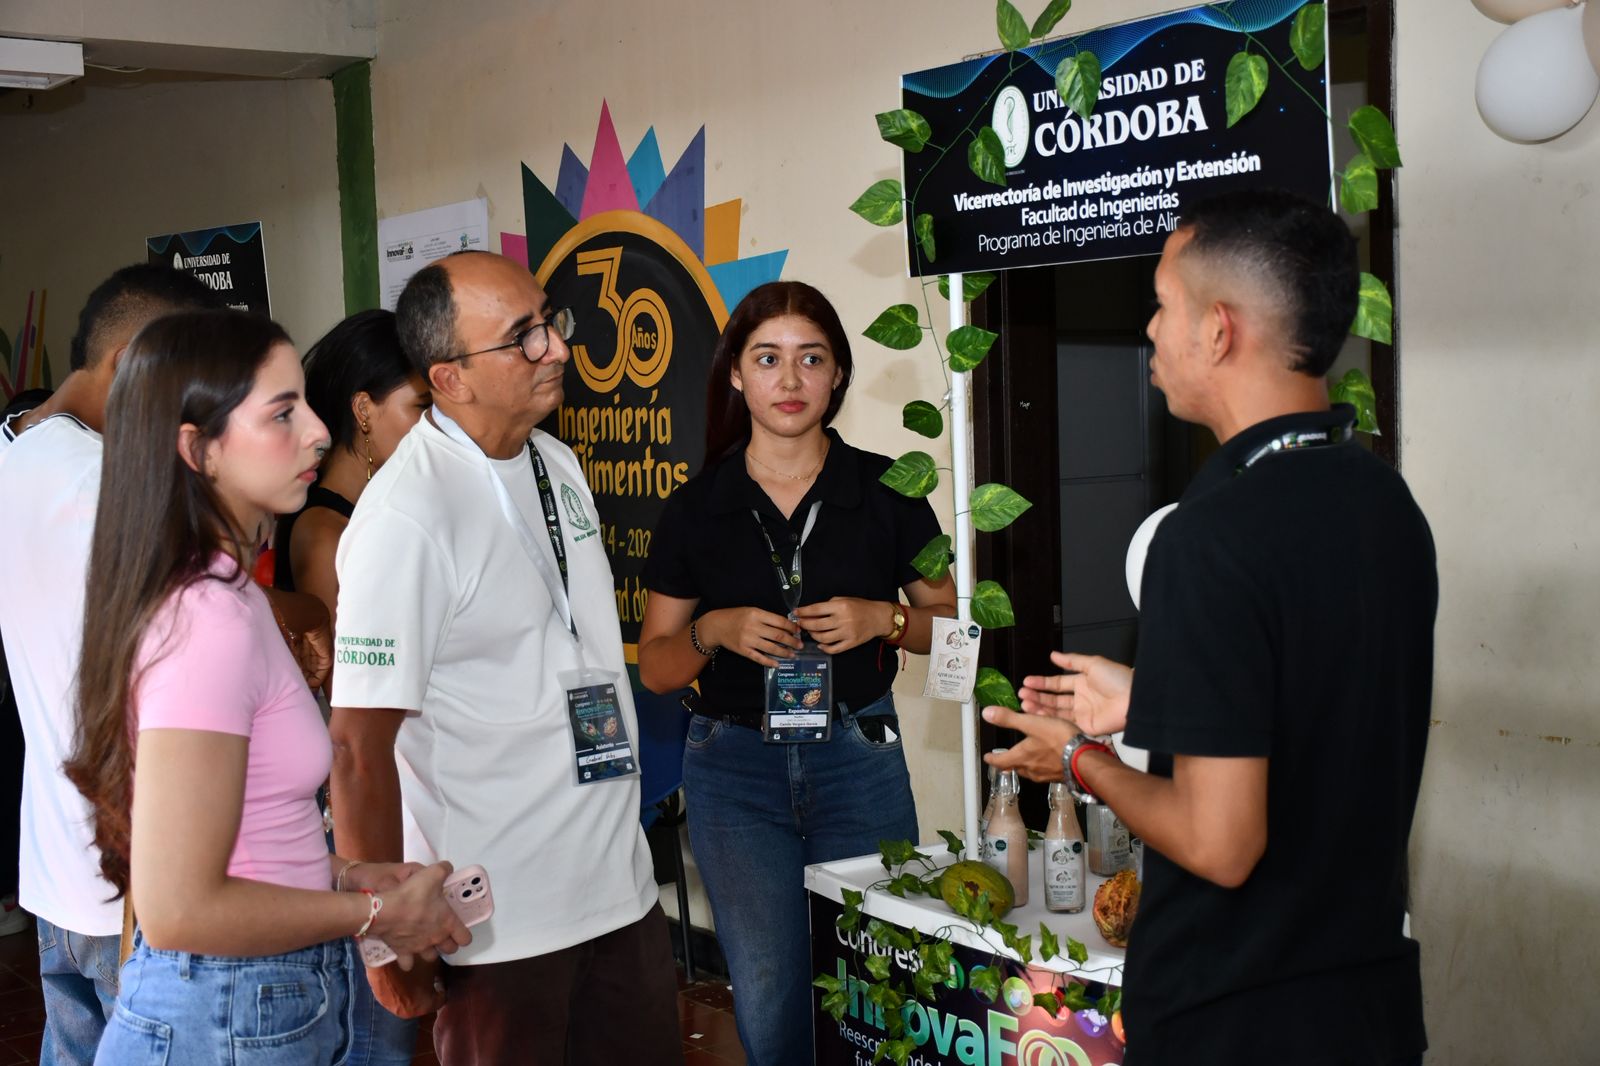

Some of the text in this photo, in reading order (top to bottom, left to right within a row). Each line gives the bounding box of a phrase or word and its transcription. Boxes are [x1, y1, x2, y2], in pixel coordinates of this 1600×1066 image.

[1033, 59, 1206, 112] UNISIDAD DE
[1034, 95, 1208, 157] CÓRDOBA
[953, 151, 1261, 211] Vicerrectoría de Investigación y Extensión
[1021, 189, 1179, 226] Facultad de Ingenierías
[978, 232, 1040, 255] Programa
[1043, 226, 1061, 245] de
[1063, 218, 1131, 246] Ingeniería
[1133, 215, 1154, 236] de
[183, 253, 231, 269] UNIVERSIDAD DE
[572, 246, 673, 393] 30
[631, 323, 657, 350] Años
[558, 389, 673, 454] Ingeniería
[574, 447, 689, 499] limentos
[337, 646, 396, 666] CÓRDOBA
[338, 636, 395, 648] UNIVERSIDAD DE
